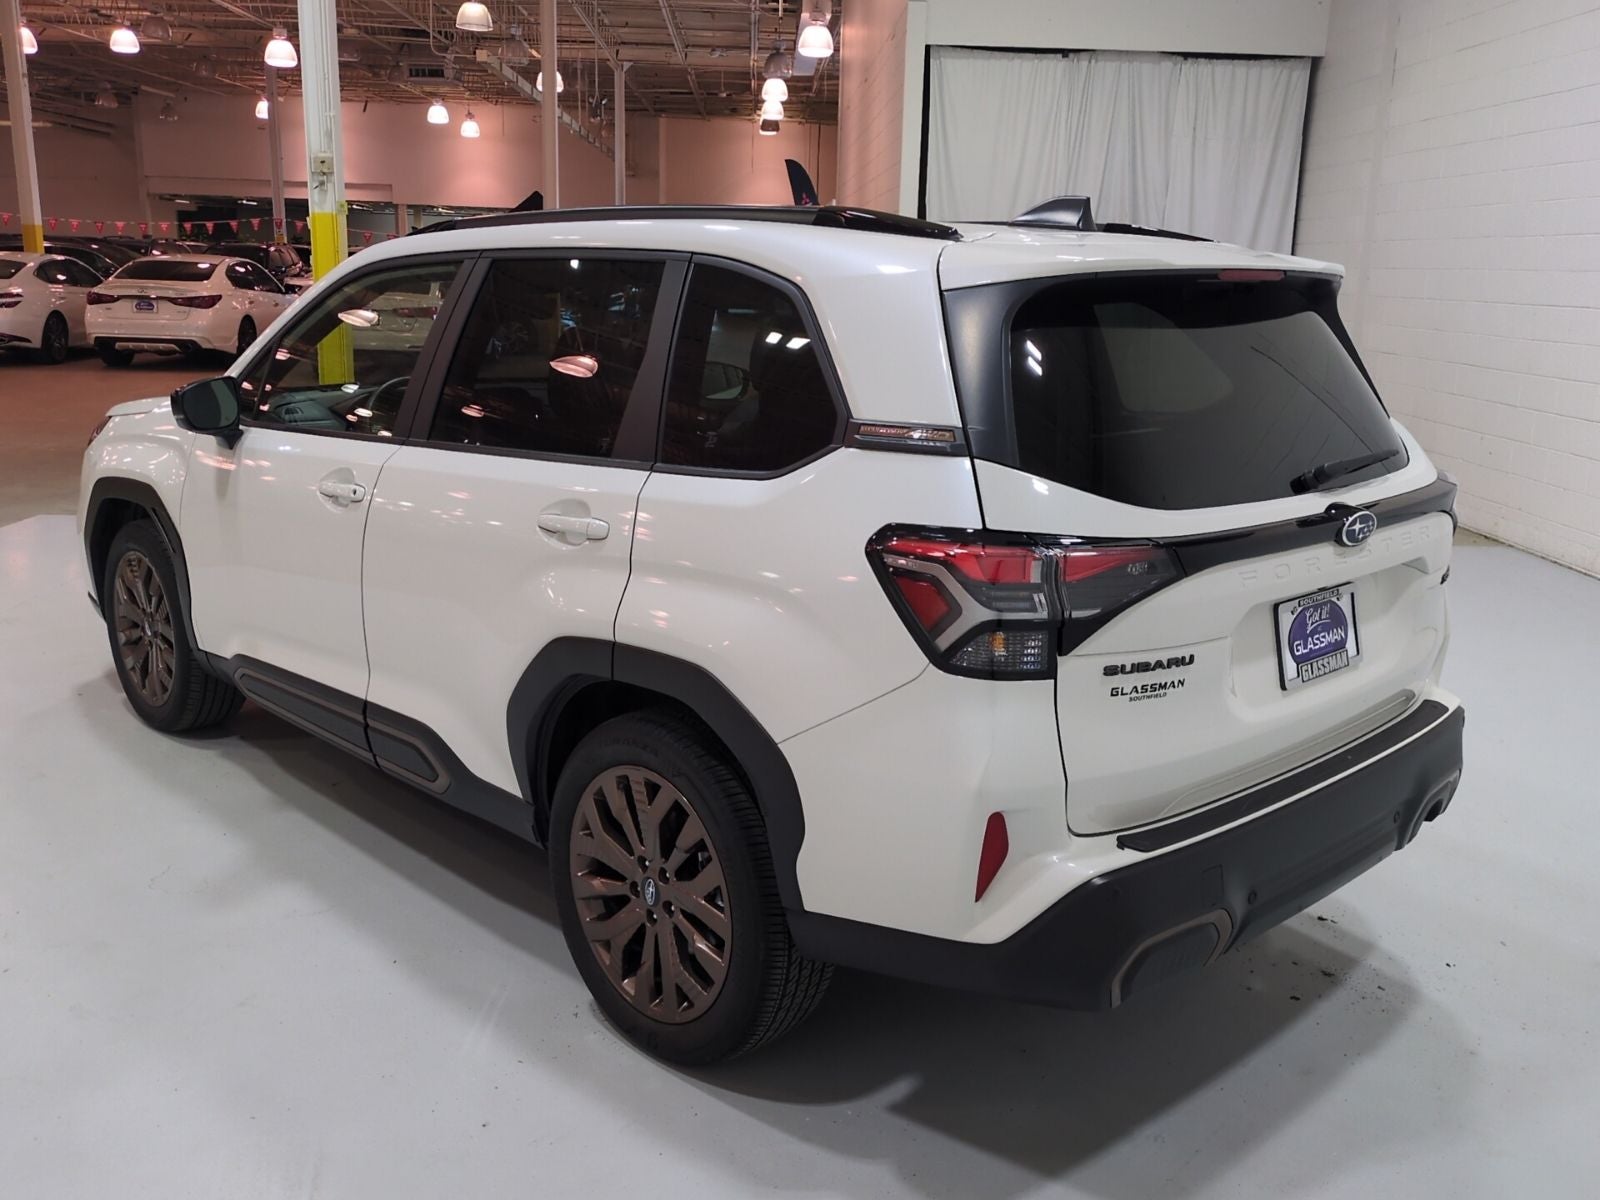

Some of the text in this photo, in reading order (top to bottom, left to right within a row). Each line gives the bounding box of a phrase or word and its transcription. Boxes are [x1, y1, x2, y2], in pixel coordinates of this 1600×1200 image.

[1299, 589, 1338, 606] SOUTHFIELD
[1305, 607, 1320, 627] Got
[1293, 626, 1345, 656] GLASSMAN
[1103, 654, 1195, 677] SUBARU
[1301, 650, 1348, 682] GLASSMAN
[1110, 678, 1186, 698] GLASSMAN
[1128, 692, 1168, 703] SOUTHFIELD
